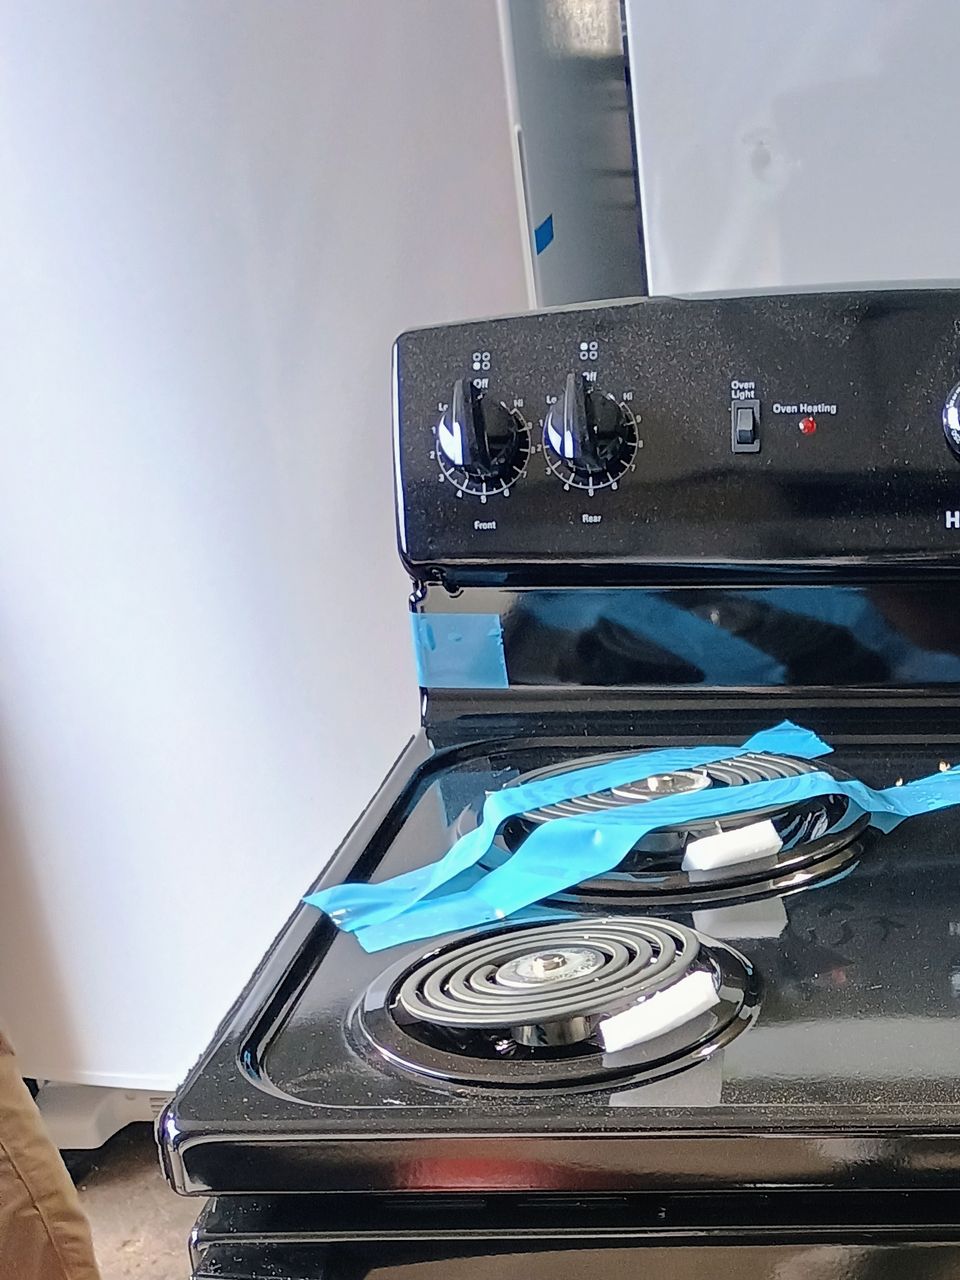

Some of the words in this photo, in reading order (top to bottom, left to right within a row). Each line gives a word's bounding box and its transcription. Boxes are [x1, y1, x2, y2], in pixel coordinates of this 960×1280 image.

[473, 378, 489, 389] Off
[731, 380, 755, 389] Oven
[546, 395, 557, 404] Lo
[623, 392, 633, 401] Hi
[731, 390, 755, 400] Light
[773, 404, 798, 414] Oven
[800, 403, 837, 414] Heating
[582, 514, 602, 523] Rear
[473, 520, 497, 531] Front
